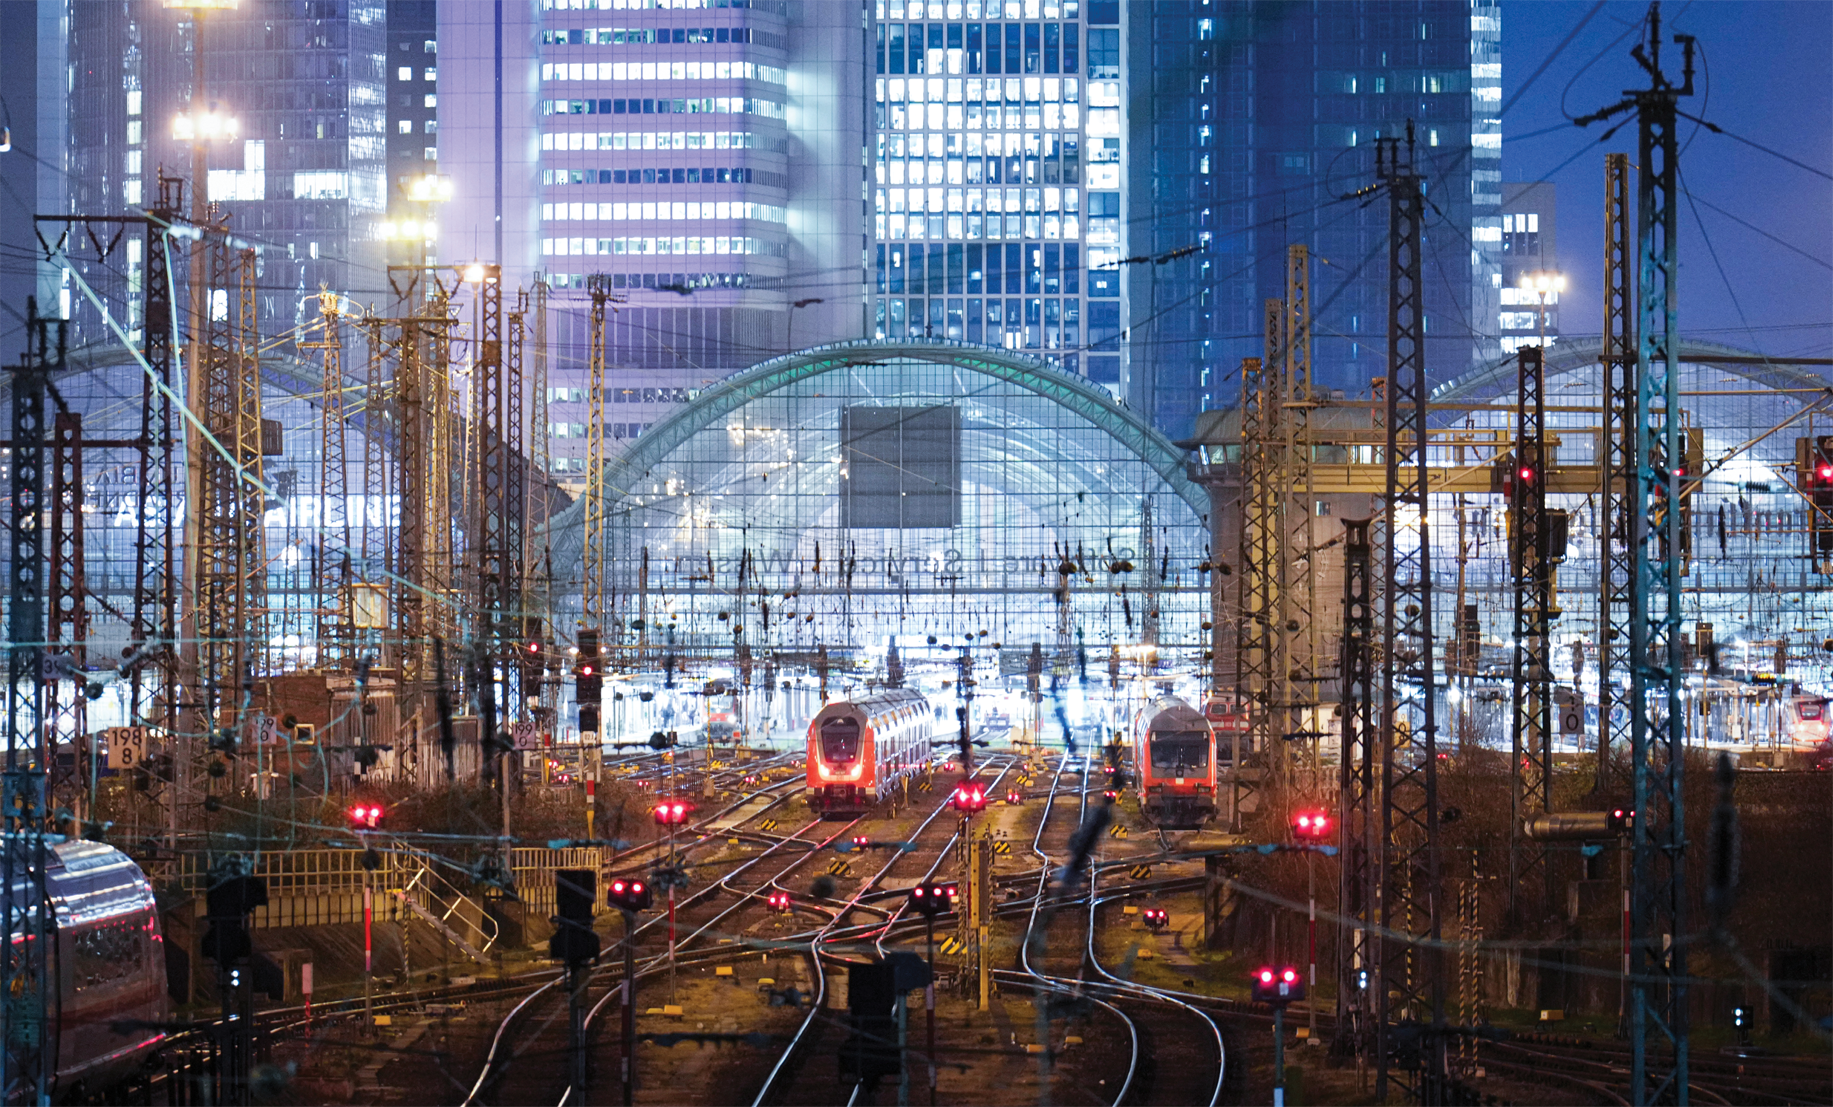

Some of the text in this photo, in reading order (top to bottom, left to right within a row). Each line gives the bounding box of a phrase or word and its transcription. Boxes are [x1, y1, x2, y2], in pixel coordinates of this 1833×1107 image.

[515, 724, 533, 735] 199
[112, 728, 142, 746] 198
[519, 736, 528, 747] 0
[122, 747, 132, 765] 8
